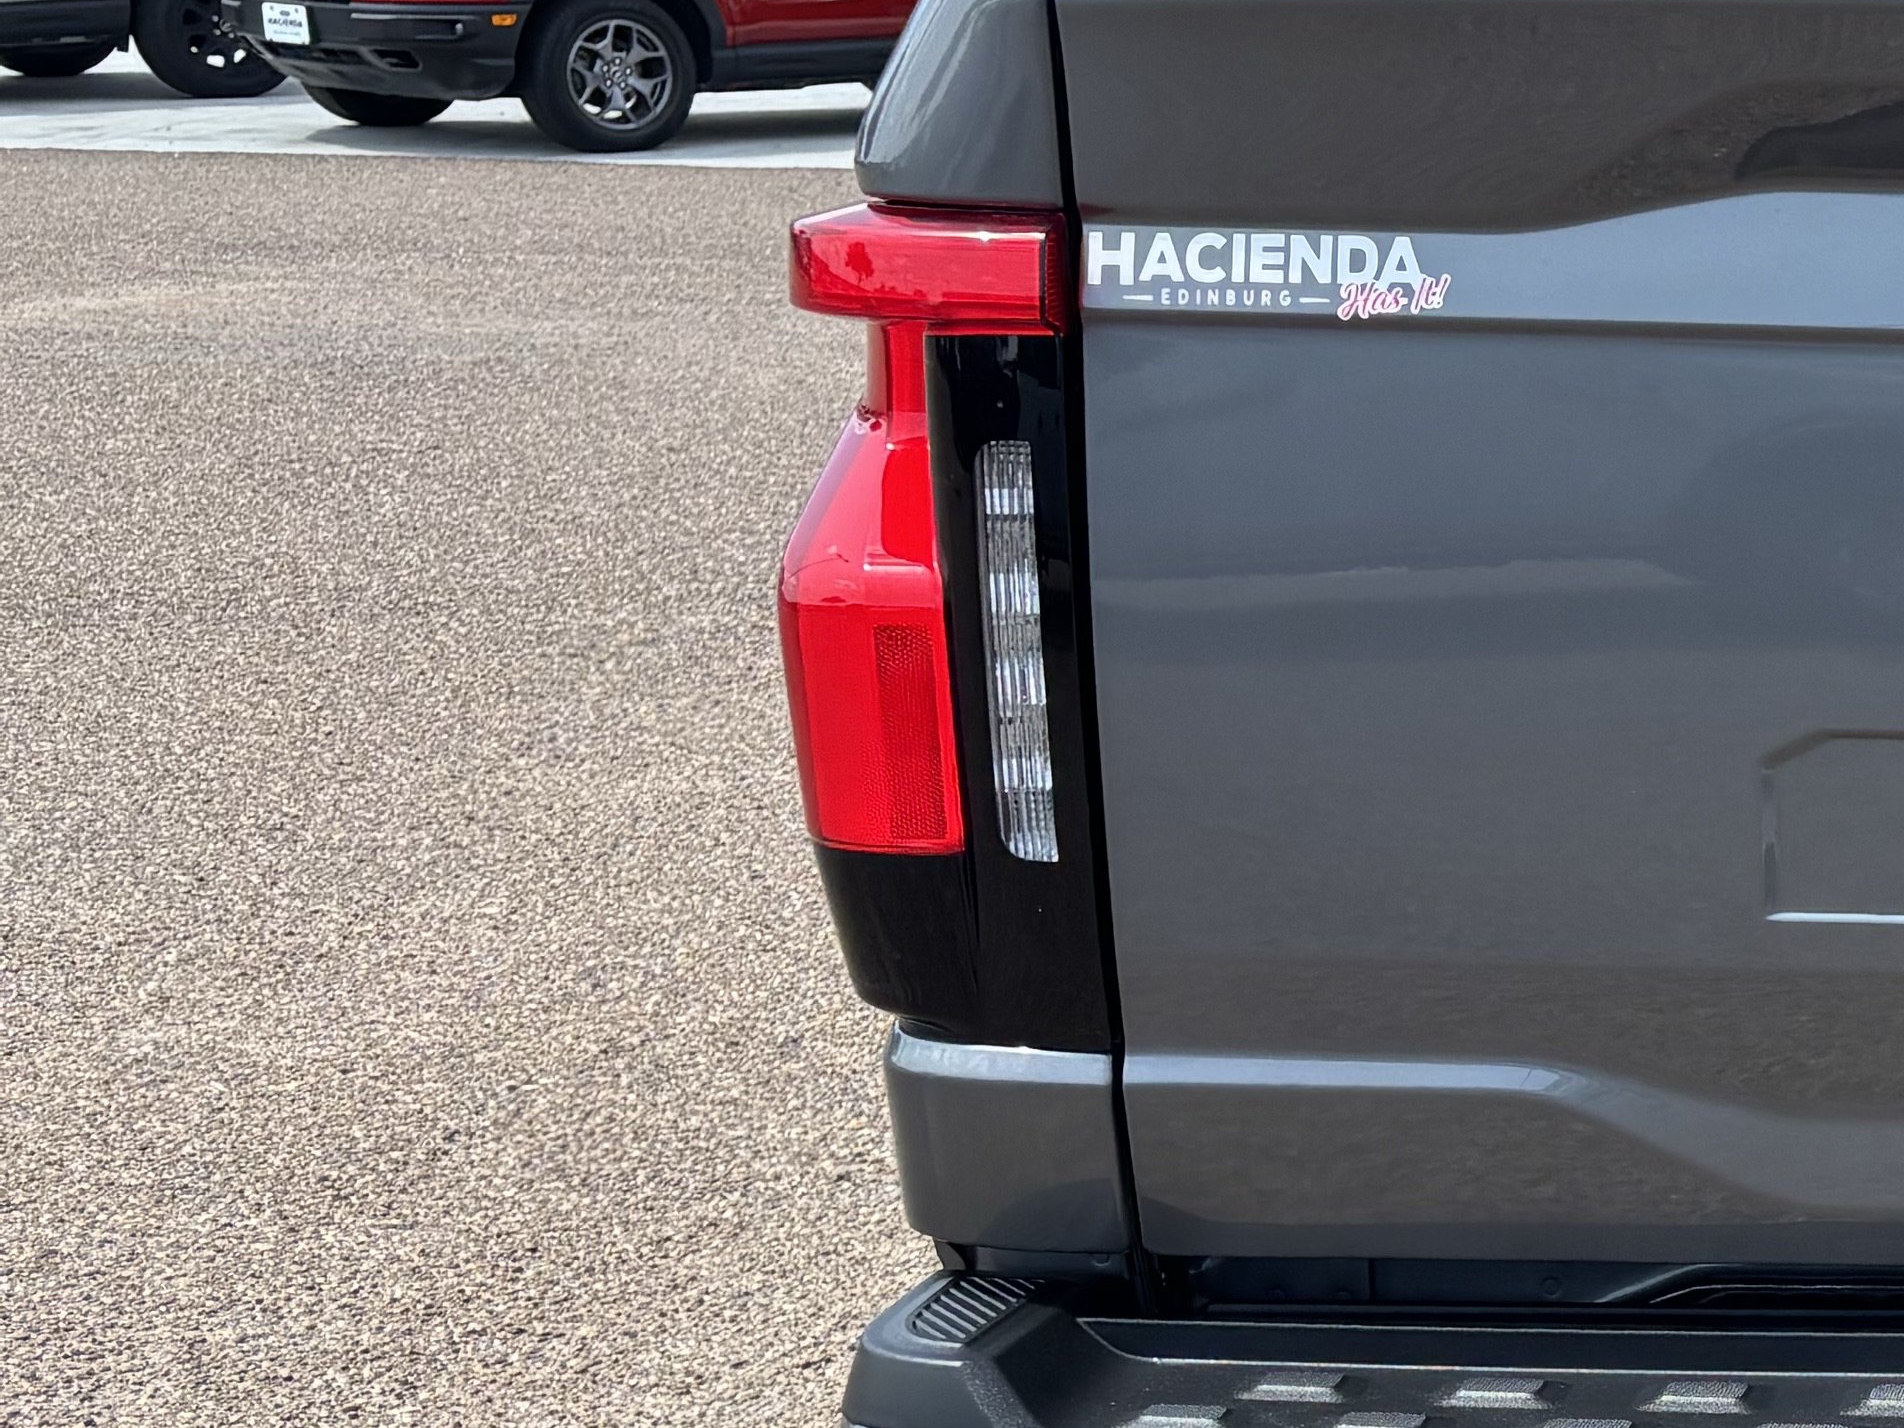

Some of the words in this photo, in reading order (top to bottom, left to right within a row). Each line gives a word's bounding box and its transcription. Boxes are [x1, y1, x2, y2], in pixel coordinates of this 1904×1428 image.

[1086, 231, 1426, 286] HACIENDA
[1160, 287, 1292, 308] EDINBURG
[1337, 279, 1409, 321] Has
[1409, 273, 1452, 315] It!
